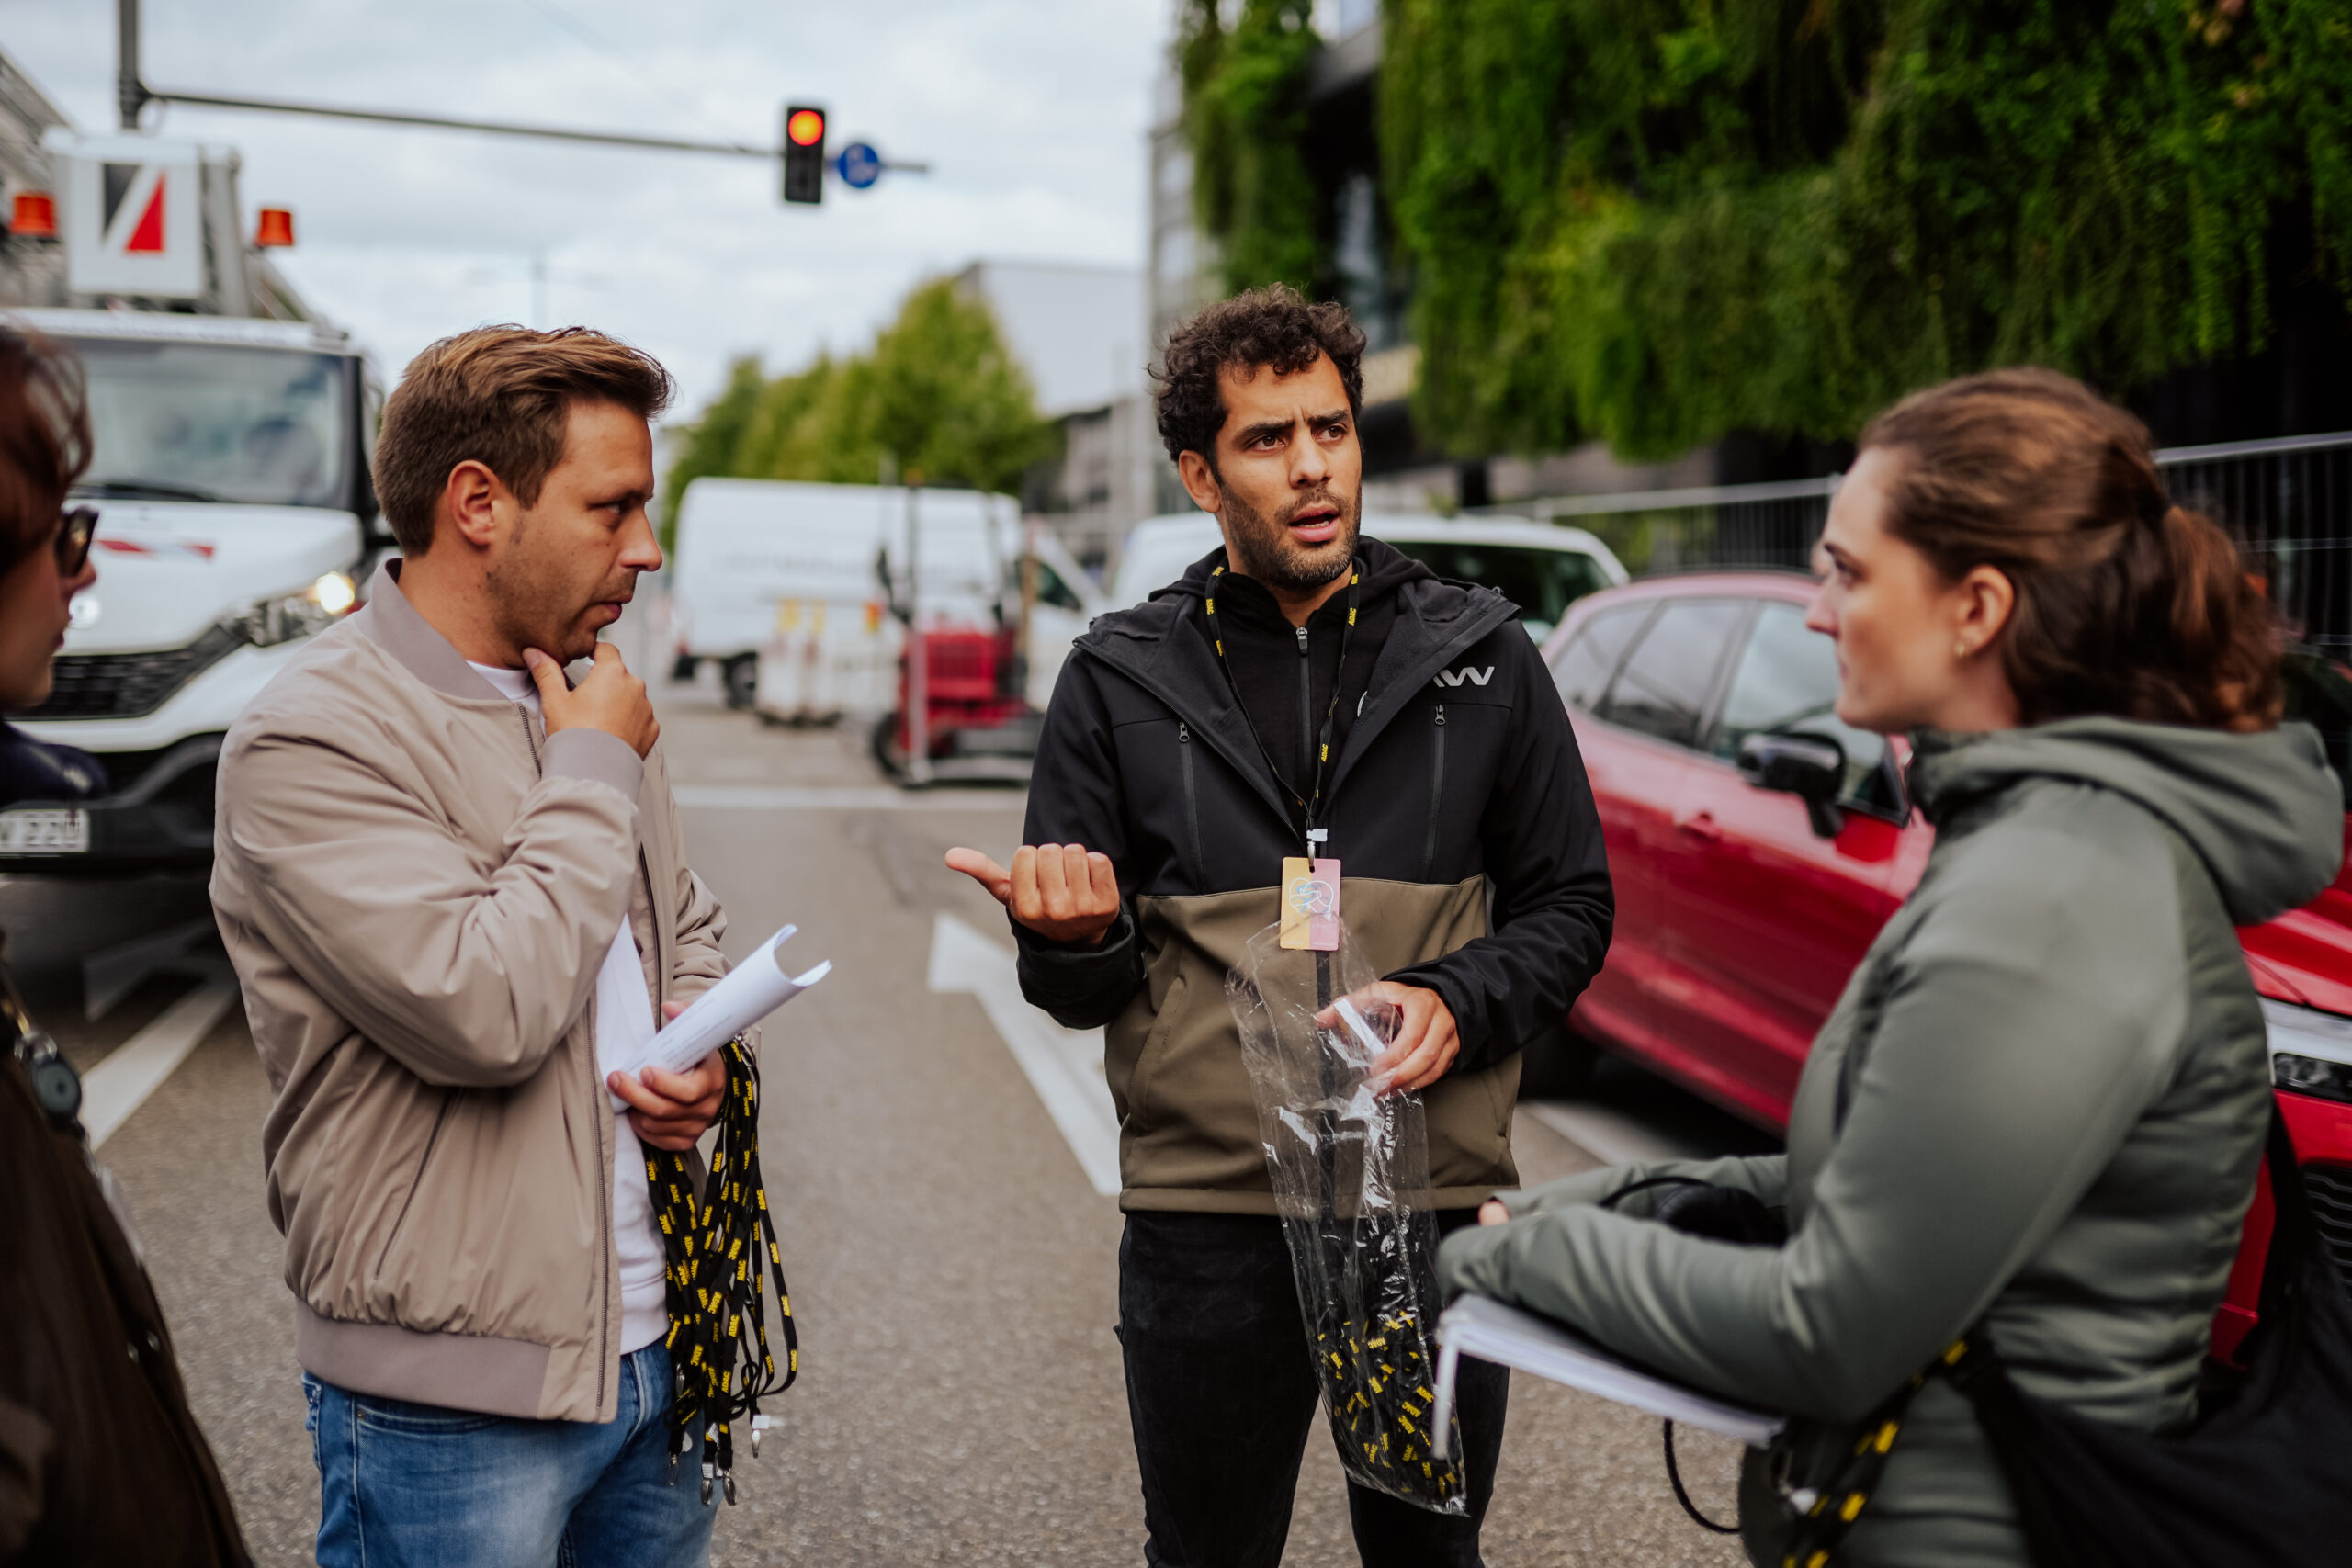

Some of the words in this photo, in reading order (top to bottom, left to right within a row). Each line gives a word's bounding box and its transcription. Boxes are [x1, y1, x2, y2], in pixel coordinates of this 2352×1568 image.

[1348, 608, 1357, 626] ADAC
[713, 1152, 723, 1172] ADAC
[702, 1206, 713, 1226] ADAC
[737, 1260, 747, 1281] ADAC
[707, 1292, 722, 1314] ADAC
[729, 1315, 740, 1337] ADAC
[691, 1345, 704, 1367] ADAC
[721, 1371, 730, 1393] ADAC
[1417, 1386, 1434, 1403] ADAC
[1402, 1401, 1421, 1417] ADAC
[1398, 1415, 1416, 1433] ADAC
